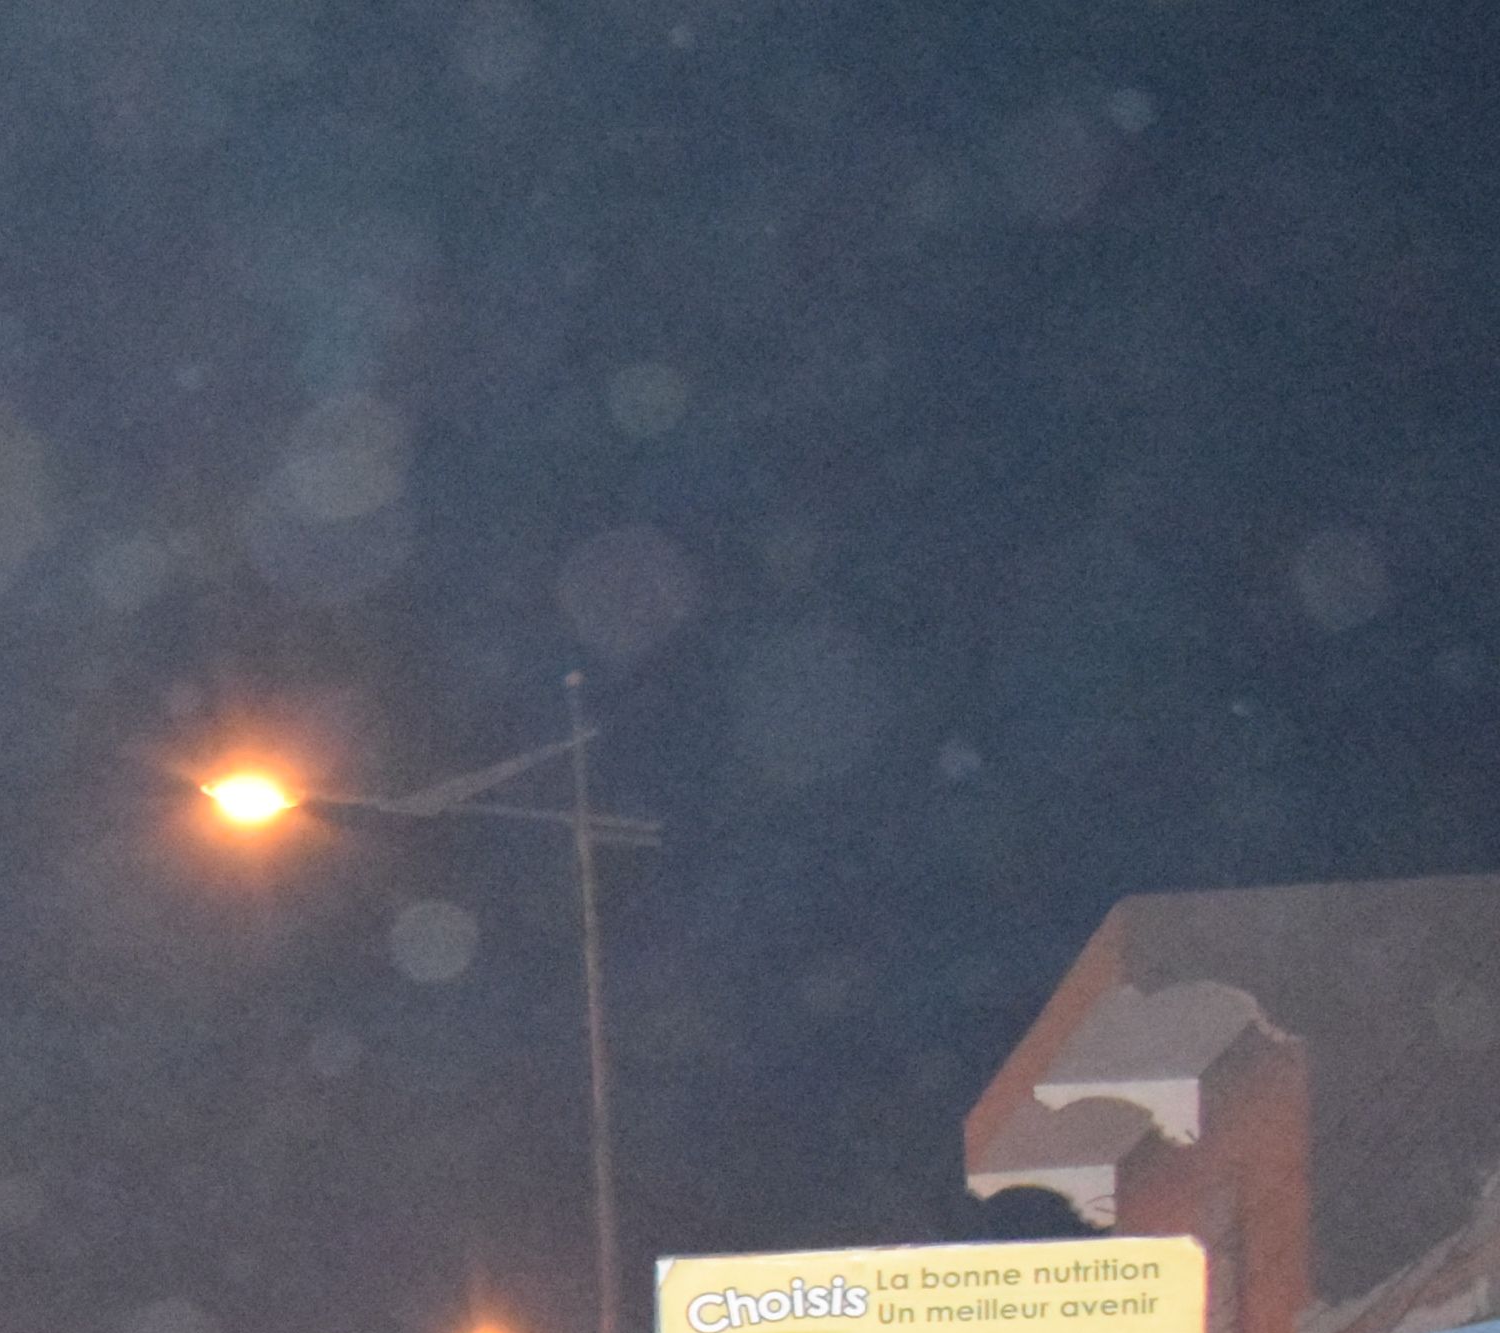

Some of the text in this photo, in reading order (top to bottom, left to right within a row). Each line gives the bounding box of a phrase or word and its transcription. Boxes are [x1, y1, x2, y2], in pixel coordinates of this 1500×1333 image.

[876, 1258, 1161, 1291] La bonne nutrition
[878, 1292, 1159, 1325] Un meilleur avenir
